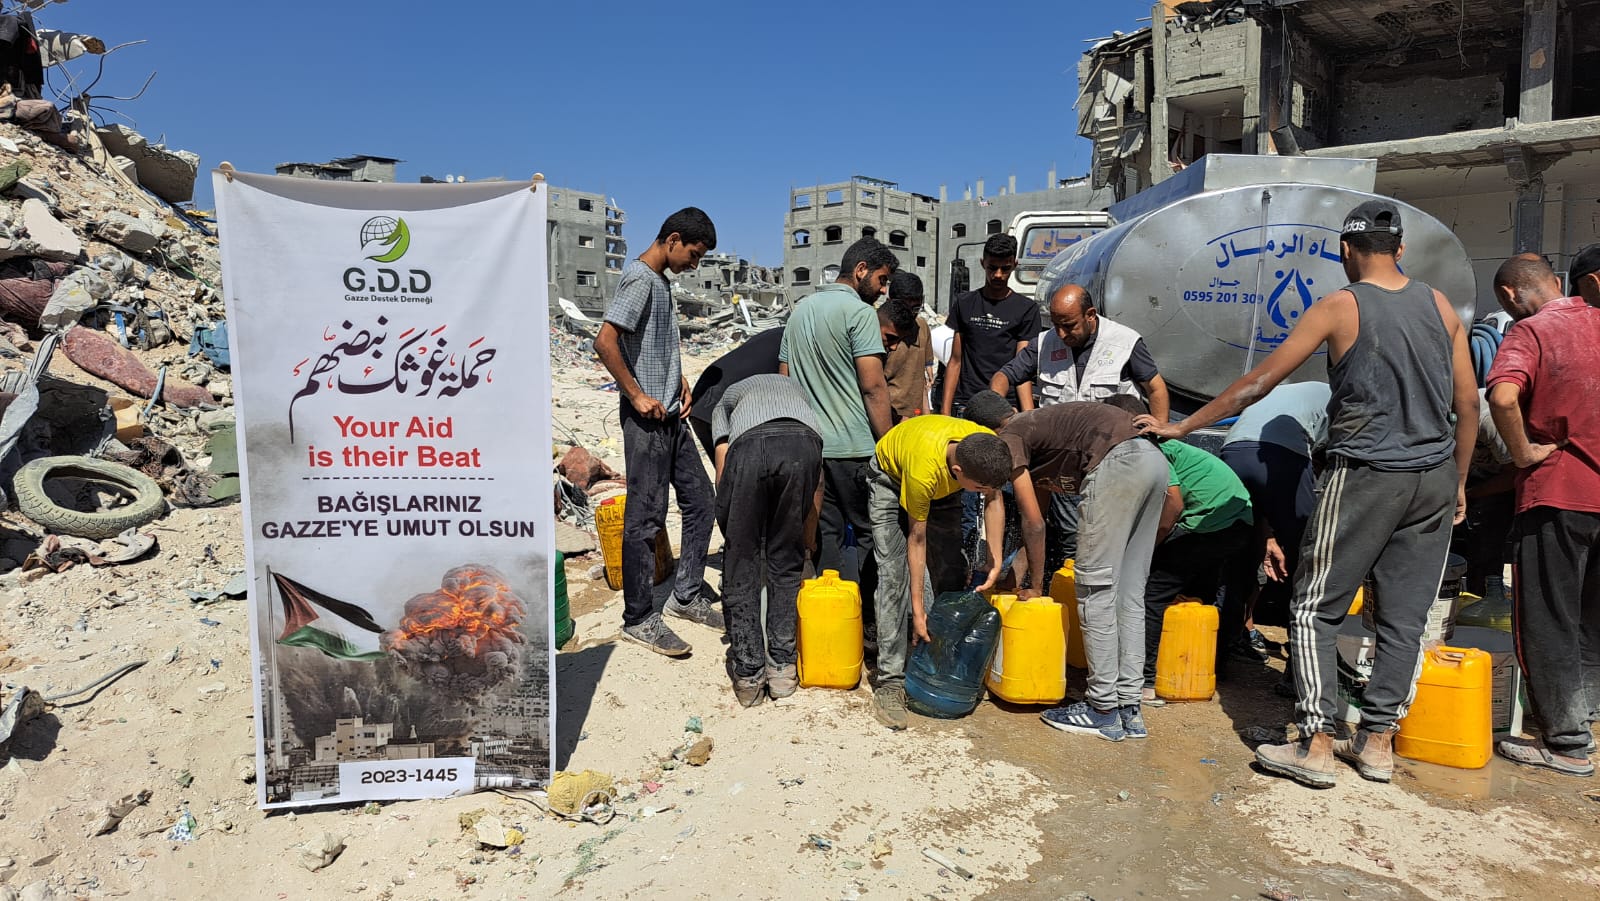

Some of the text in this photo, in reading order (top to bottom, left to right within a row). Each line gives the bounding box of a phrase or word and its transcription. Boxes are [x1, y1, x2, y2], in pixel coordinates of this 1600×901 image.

[1215, 233, 1304, 268] الرمال
[343, 267, 431, 293] G.D.D
[1209, 277, 1240, 289] جوال
[344, 294, 432, 304] Gazze Destek Derneği
[1183, 290, 1213, 302] 0595
[1216, 292, 1238, 303] 201
[333, 416, 453, 438] Your Aid
[309, 445, 481, 468] is their Beat
[317, 491, 482, 516] BAĞIŞLARINIZ
[261, 520, 534, 539] GAZZE'YE UMUT OLSUN
[361, 768, 458, 784] 2023-1445
